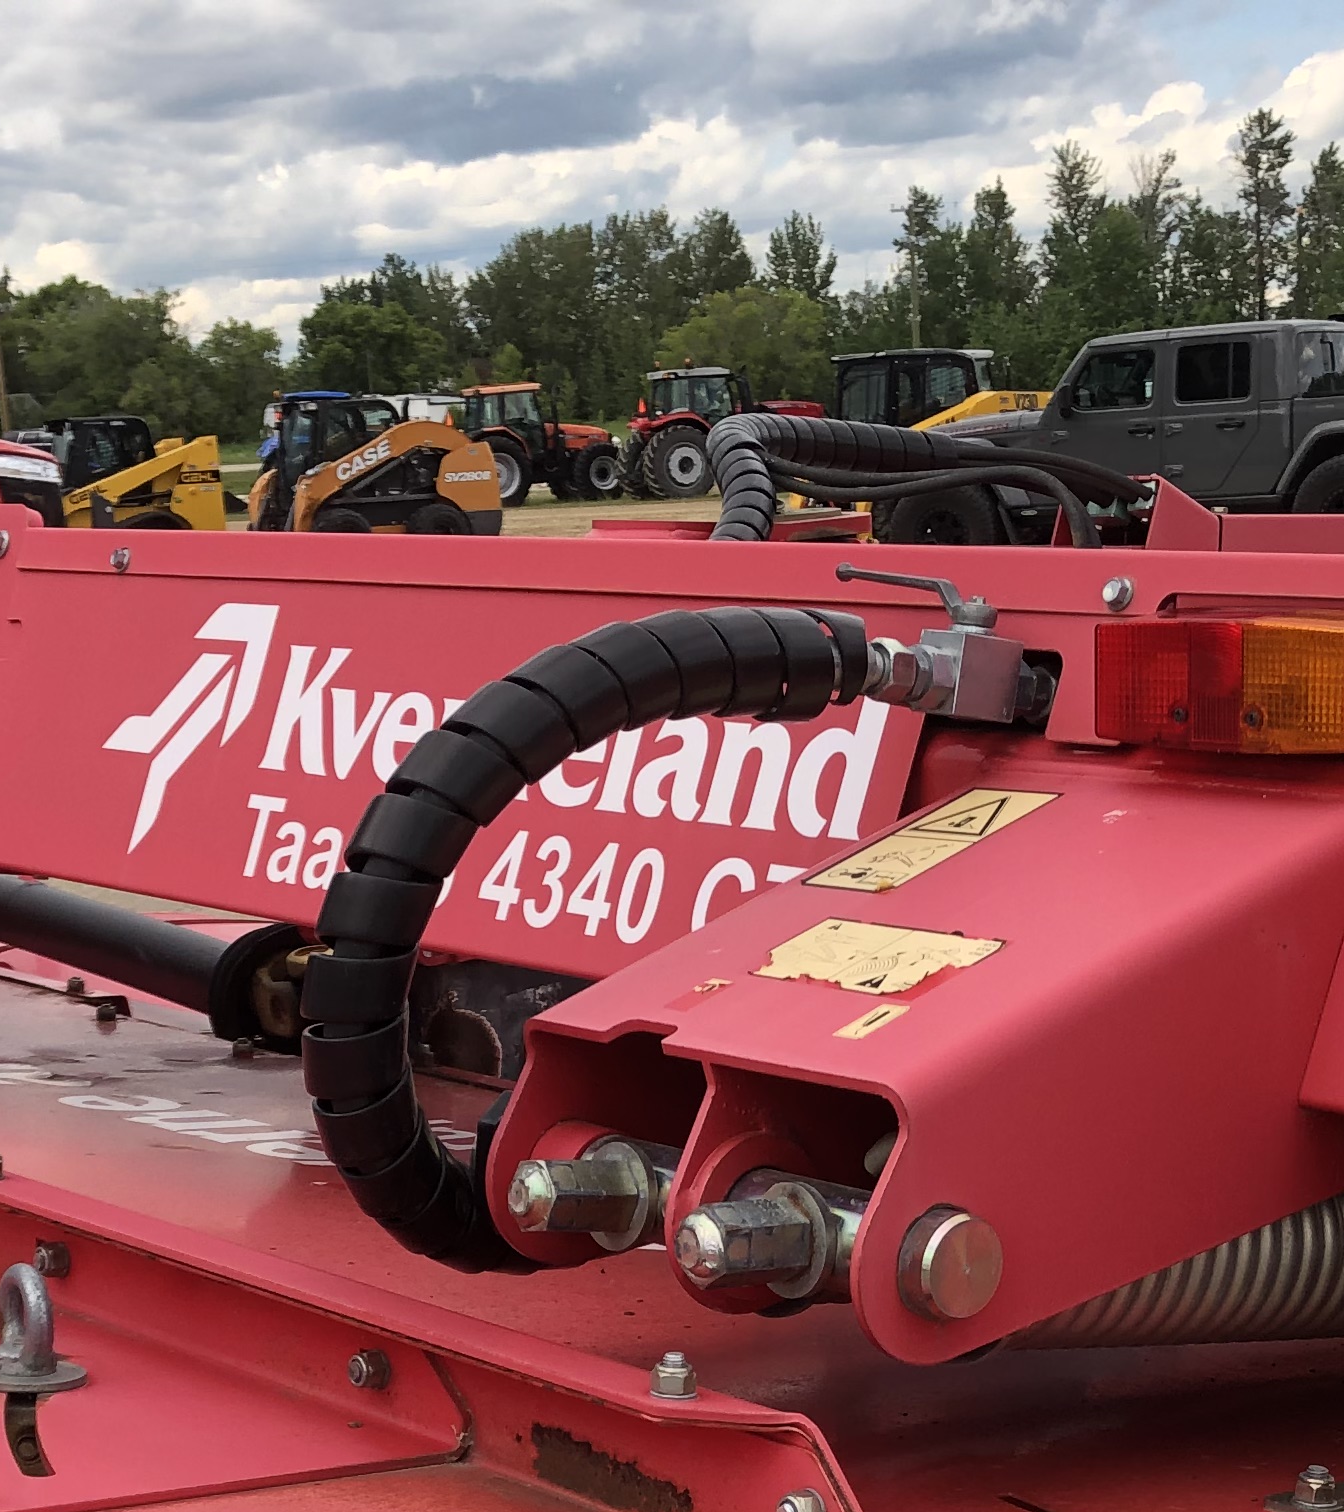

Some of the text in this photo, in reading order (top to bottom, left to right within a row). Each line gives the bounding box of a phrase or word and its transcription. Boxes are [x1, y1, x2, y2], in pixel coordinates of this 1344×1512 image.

[180, 472, 218, 483] GEHL
[336, 439, 392, 481] CASE
[68, 485, 108, 505] GEL
[258, 644, 891, 841] Kveeland
[242, 793, 454, 910] Taa
[478, 830, 665, 945] 4340
